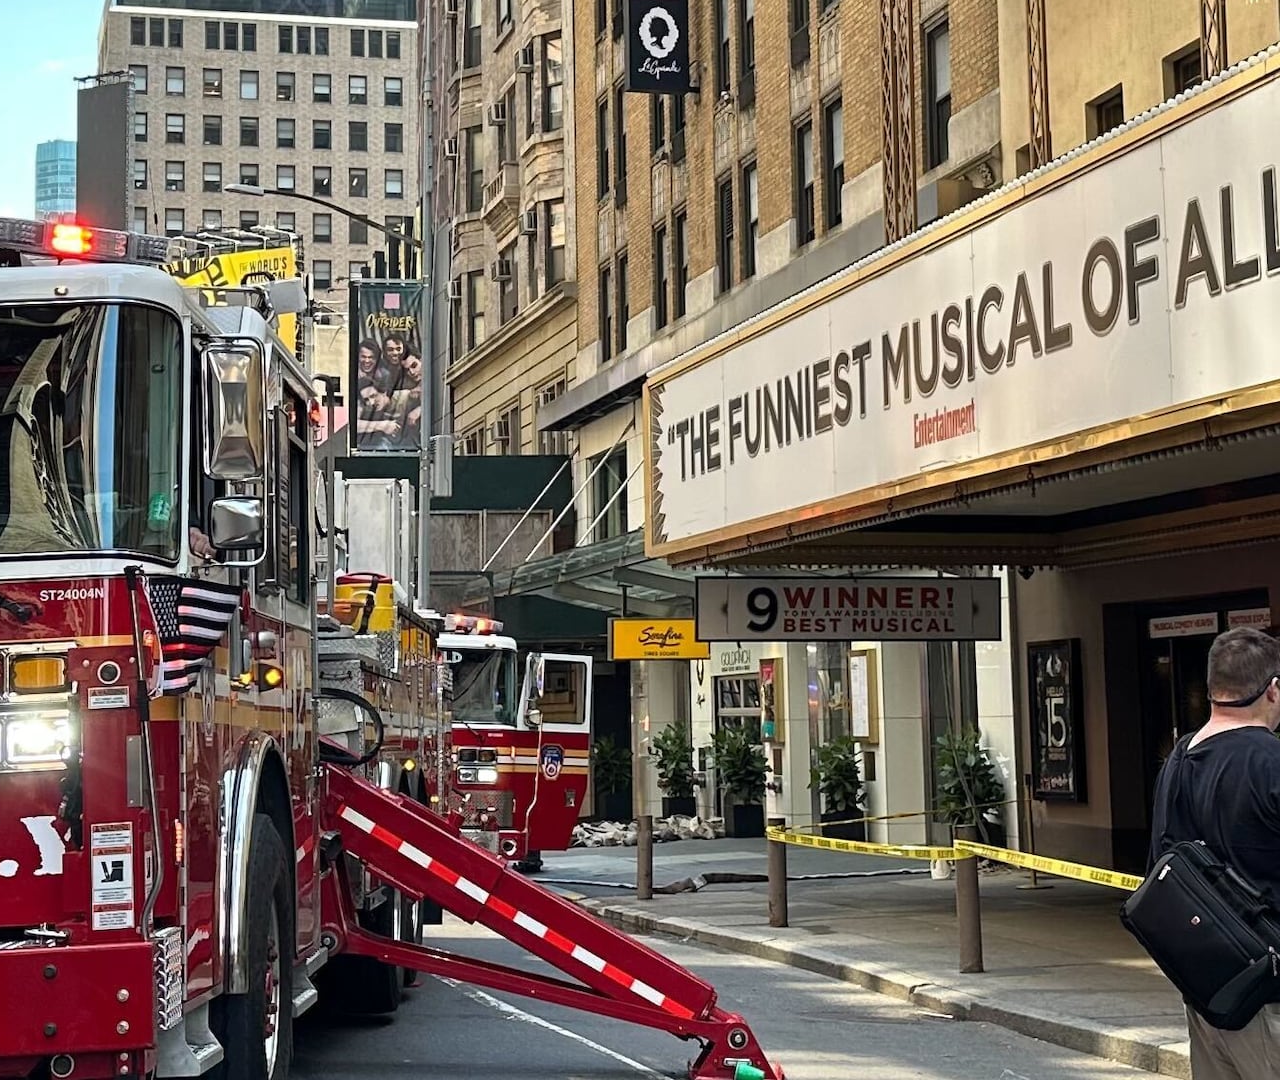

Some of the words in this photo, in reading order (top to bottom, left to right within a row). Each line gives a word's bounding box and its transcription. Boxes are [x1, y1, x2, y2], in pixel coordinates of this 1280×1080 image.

[366, 313, 416, 330] OUTSIDERS
[667, 404, 721, 482] “THE
[728, 338, 872, 466] FUNNIEST
[881, 260, 1073, 410] MUSICAL
[1082, 214, 1161, 337] OF
[914, 398, 977, 449] Entertainment
[39, 587, 104, 602] ST24004N
[747, 587, 779, 633] 9
[783, 587, 955, 609] WINNER!
[783, 619, 843, 633] BEST
[852, 619, 955, 633] MUSICAL
[1045, 697, 1067, 748] 15
